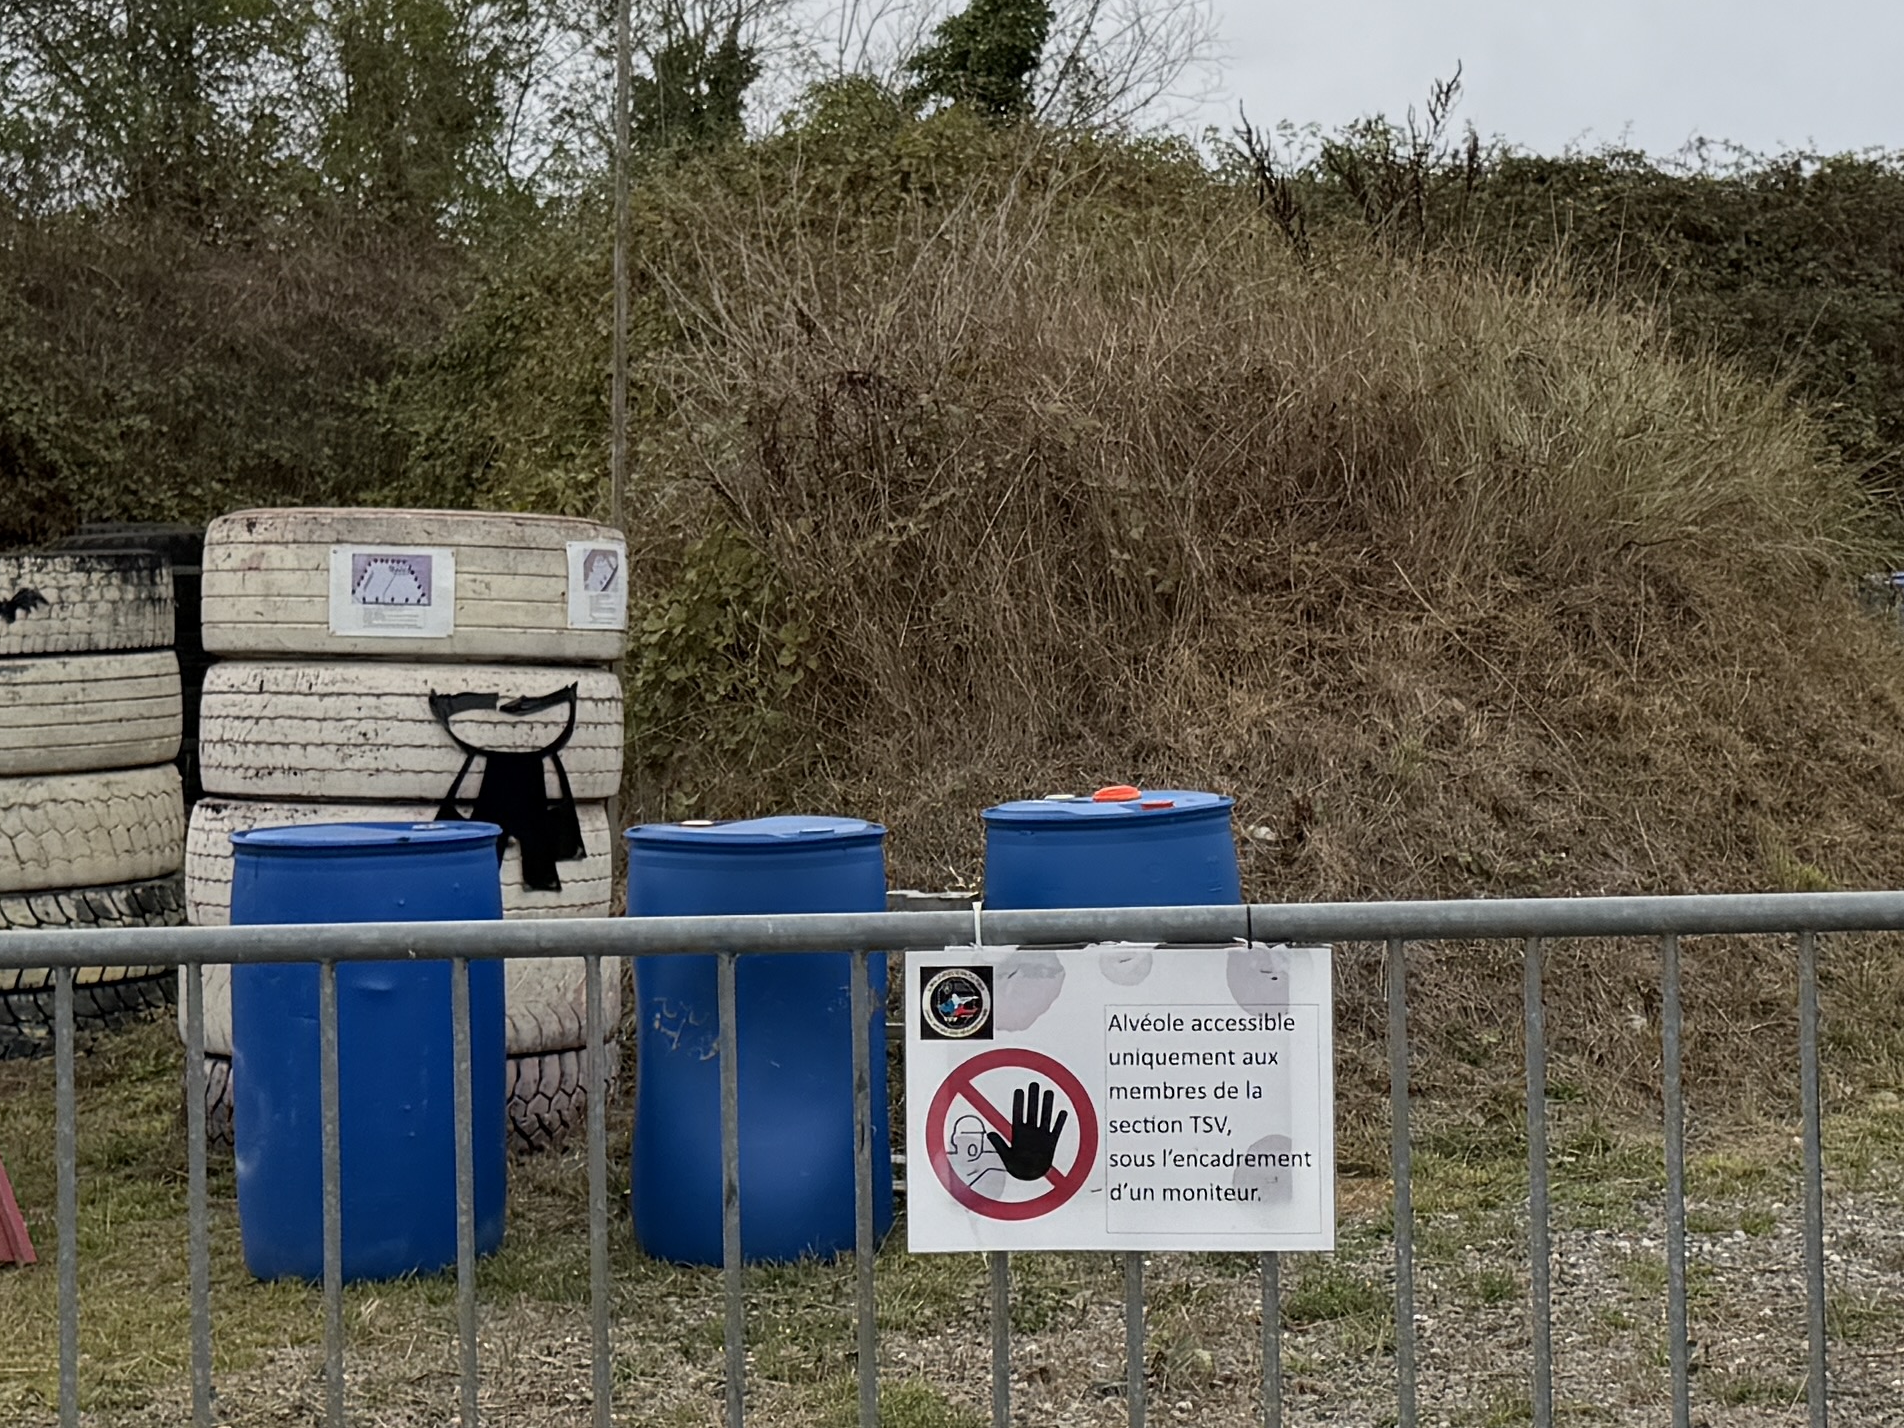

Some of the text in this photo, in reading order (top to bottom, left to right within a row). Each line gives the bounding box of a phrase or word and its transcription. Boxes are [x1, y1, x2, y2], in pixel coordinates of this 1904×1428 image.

[1108, 1013, 1295, 1032] Alvéole accessible
[1109, 1048, 1279, 1071] uniquement aux
[1109, 1080, 1263, 1100] membres de la
[1109, 1115, 1232, 1137] section TSV,
[1109, 1148, 1312, 1168] sous l’encadrement
[1109, 1183, 1262, 1203] d’un moniteur.
